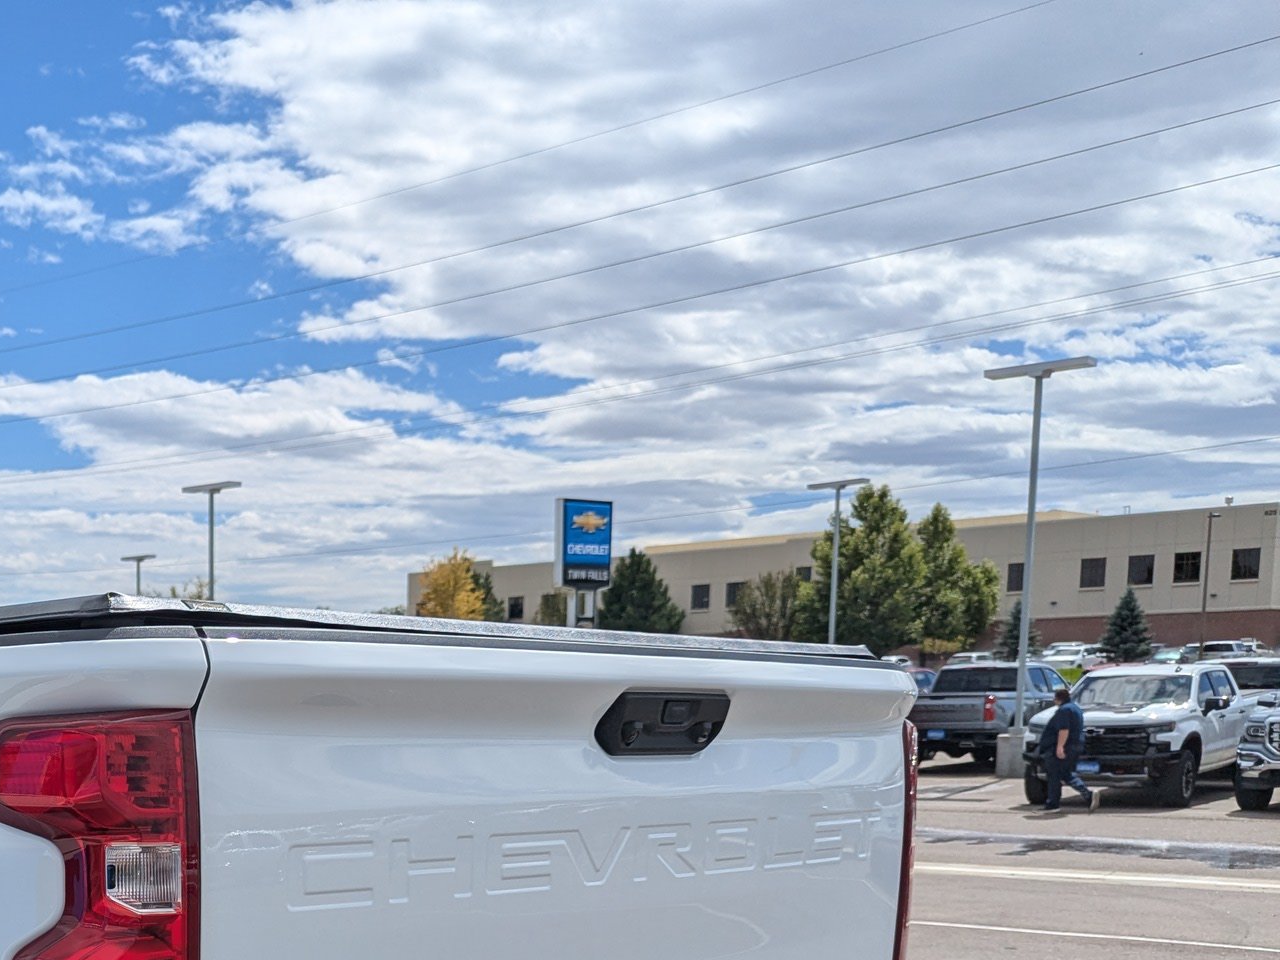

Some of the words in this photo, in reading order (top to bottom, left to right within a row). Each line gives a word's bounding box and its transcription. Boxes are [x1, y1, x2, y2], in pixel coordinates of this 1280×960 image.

[567, 544, 609, 556] CHEVROLET
[568, 569, 587, 580] TWIN
[587, 570, 609, 582] FALLS
[287, 809, 882, 911] CHEVROLET
